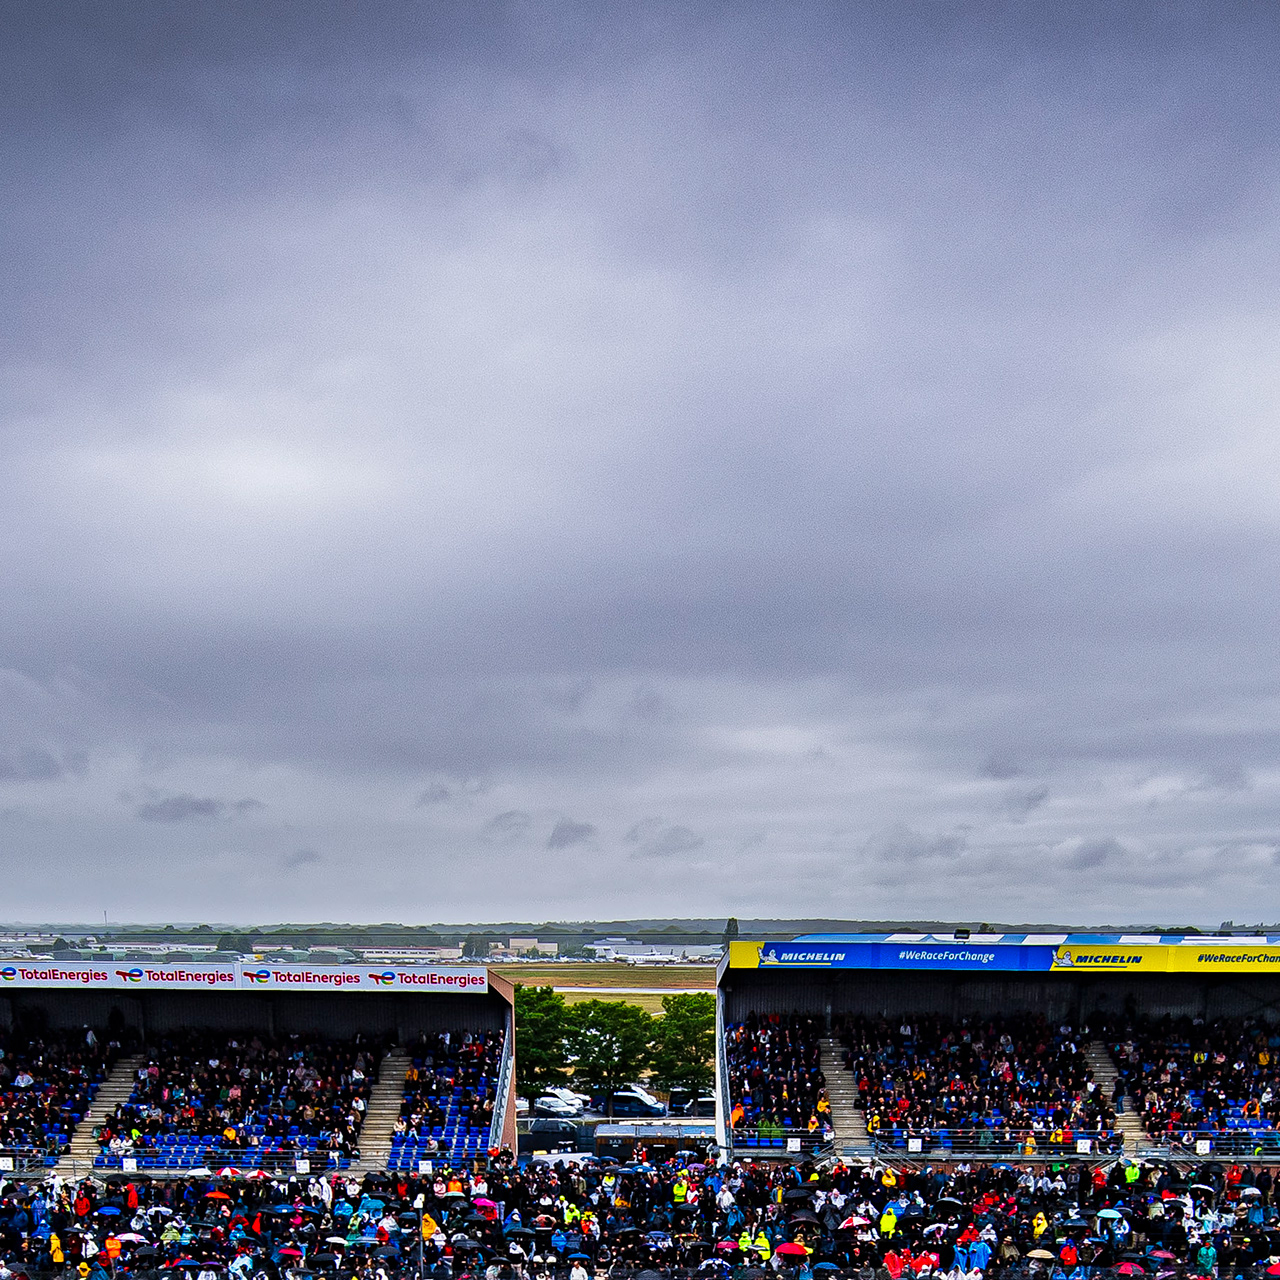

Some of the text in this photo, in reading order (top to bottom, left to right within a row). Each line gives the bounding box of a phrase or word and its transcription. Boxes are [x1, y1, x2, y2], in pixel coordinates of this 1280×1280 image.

[780, 952, 845, 962] MICHELIN
[900, 951, 994, 963] #WeRaceForChange
[1075, 955, 1142, 964] MICHELIN
[19, 969, 107, 983] TotalEnergies
[145, 971, 233, 984] TotalEnergies
[272, 972, 360, 986] TotalEnergies
[397, 973, 488, 987] TotalEnergies
